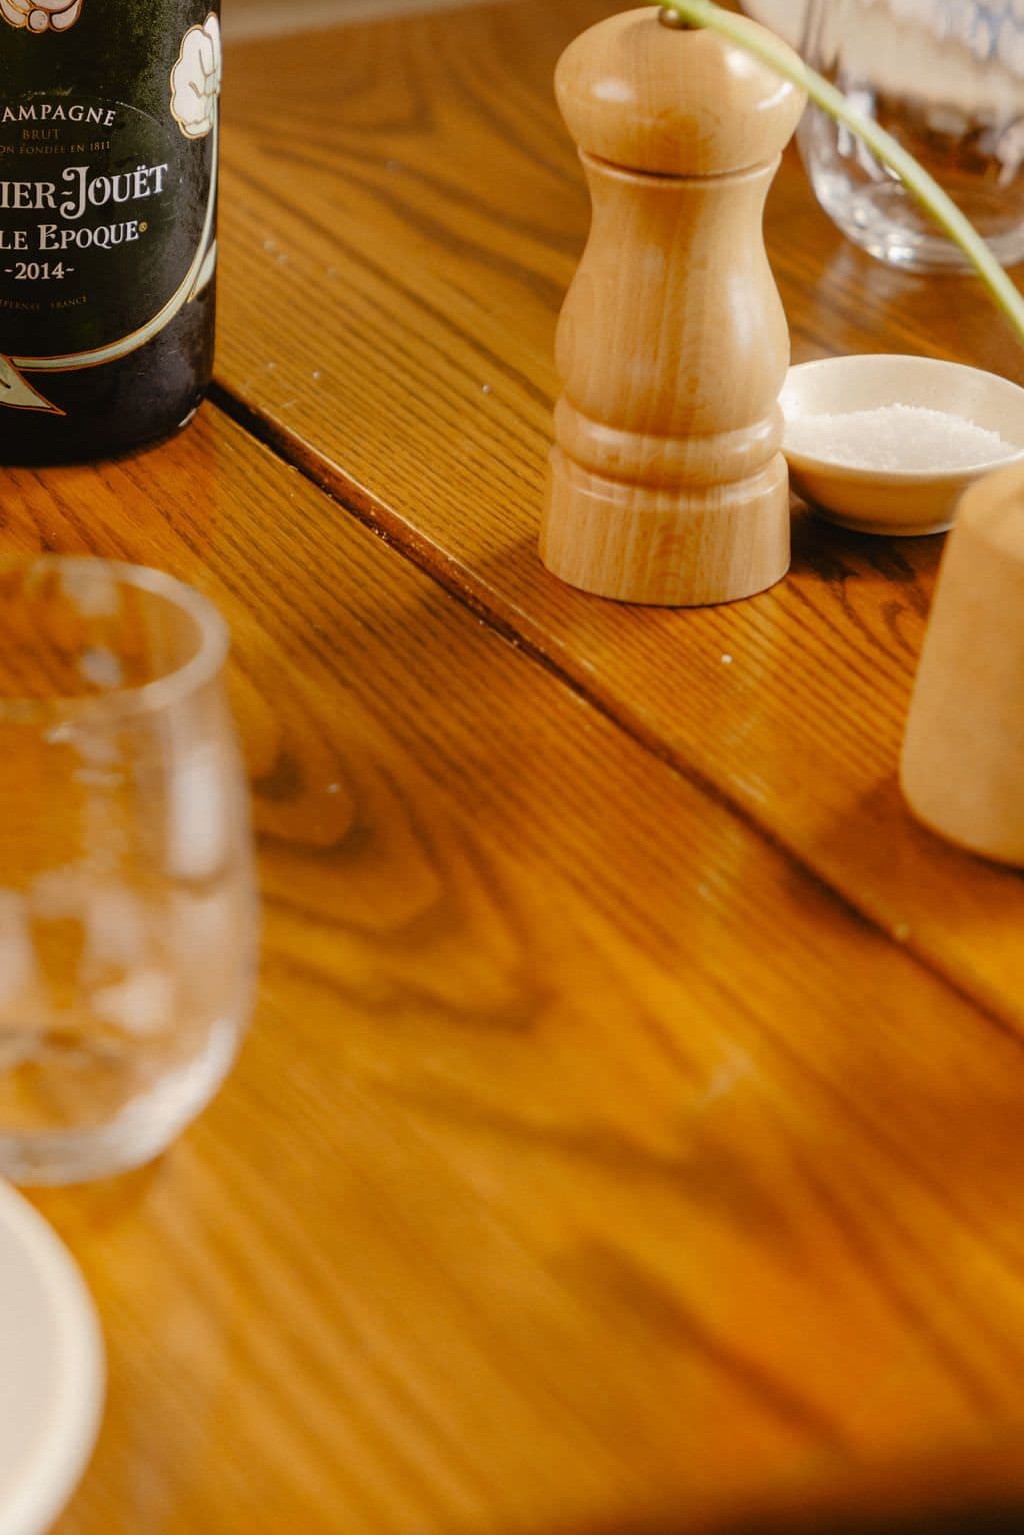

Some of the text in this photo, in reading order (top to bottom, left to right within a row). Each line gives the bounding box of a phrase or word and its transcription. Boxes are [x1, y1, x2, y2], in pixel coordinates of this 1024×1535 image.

[22, 129, 61, 140] BRUT
[70, 144, 85, 153] EN
[90, 140, 111, 152] 1811
